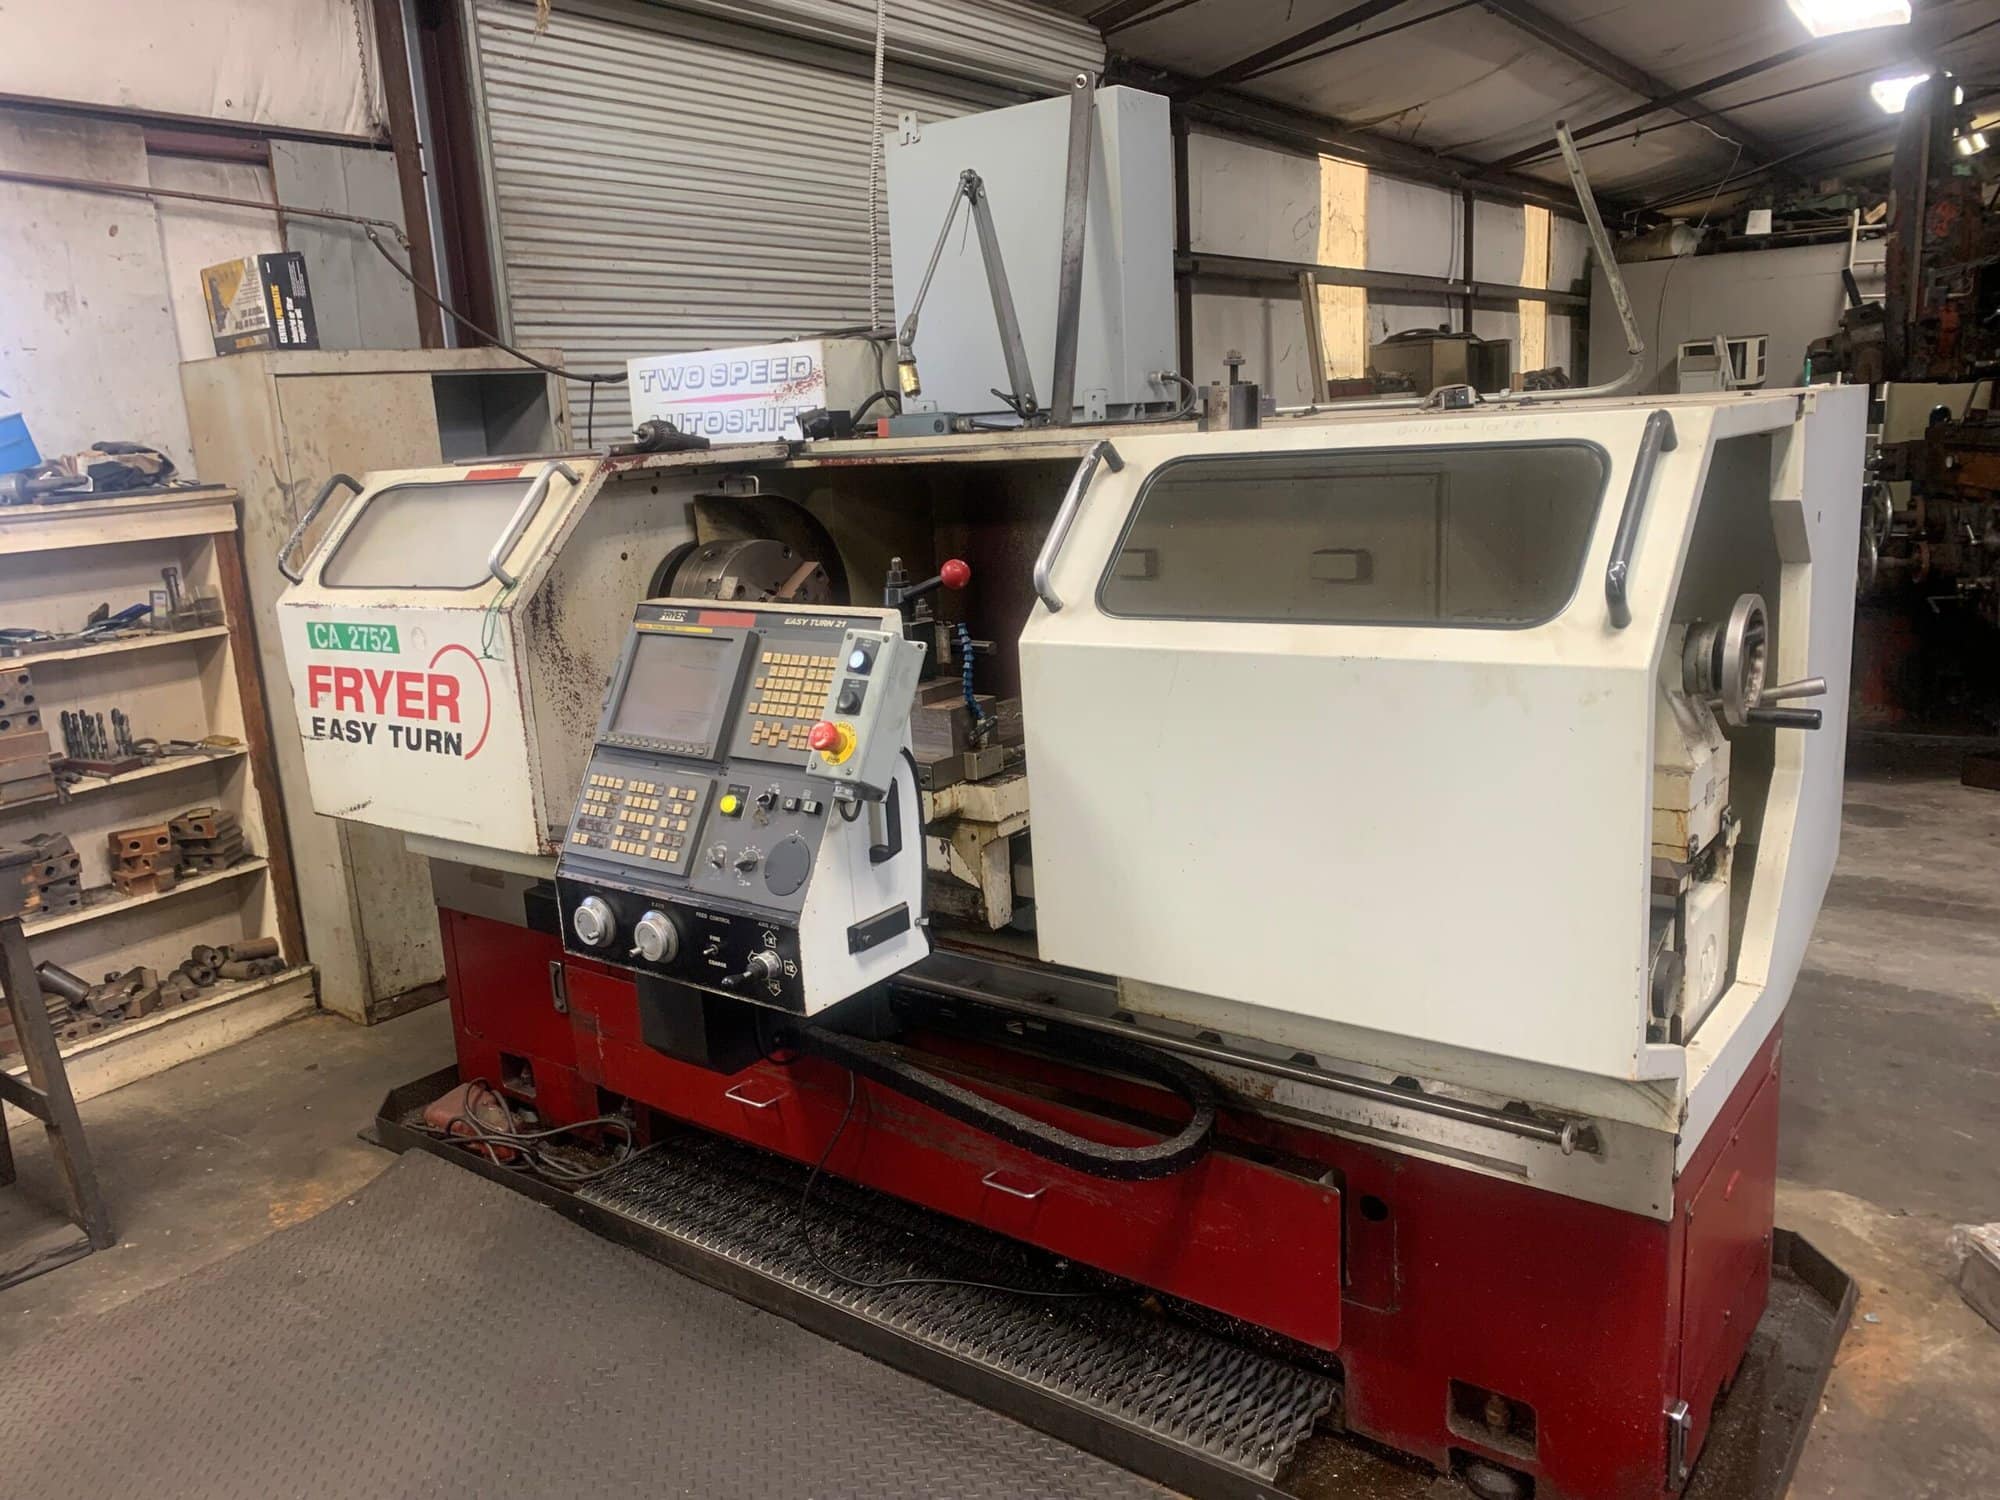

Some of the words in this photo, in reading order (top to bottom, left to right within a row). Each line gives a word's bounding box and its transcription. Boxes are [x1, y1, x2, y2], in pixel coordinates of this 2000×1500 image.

[640, 365, 705, 393] TWO
[710, 355, 813, 387] SPEED
[651, 405, 817, 436] UTOSHIF
[314, 623, 342, 649] CA
[348, 626, 394, 652] 2752
[784, 617, 808, 626] EASY
[809, 618, 835, 628] TURN
[308, 665, 461, 724] FRYER
[312, 716, 377, 745] EASY
[388, 724, 462, 756] TURN
